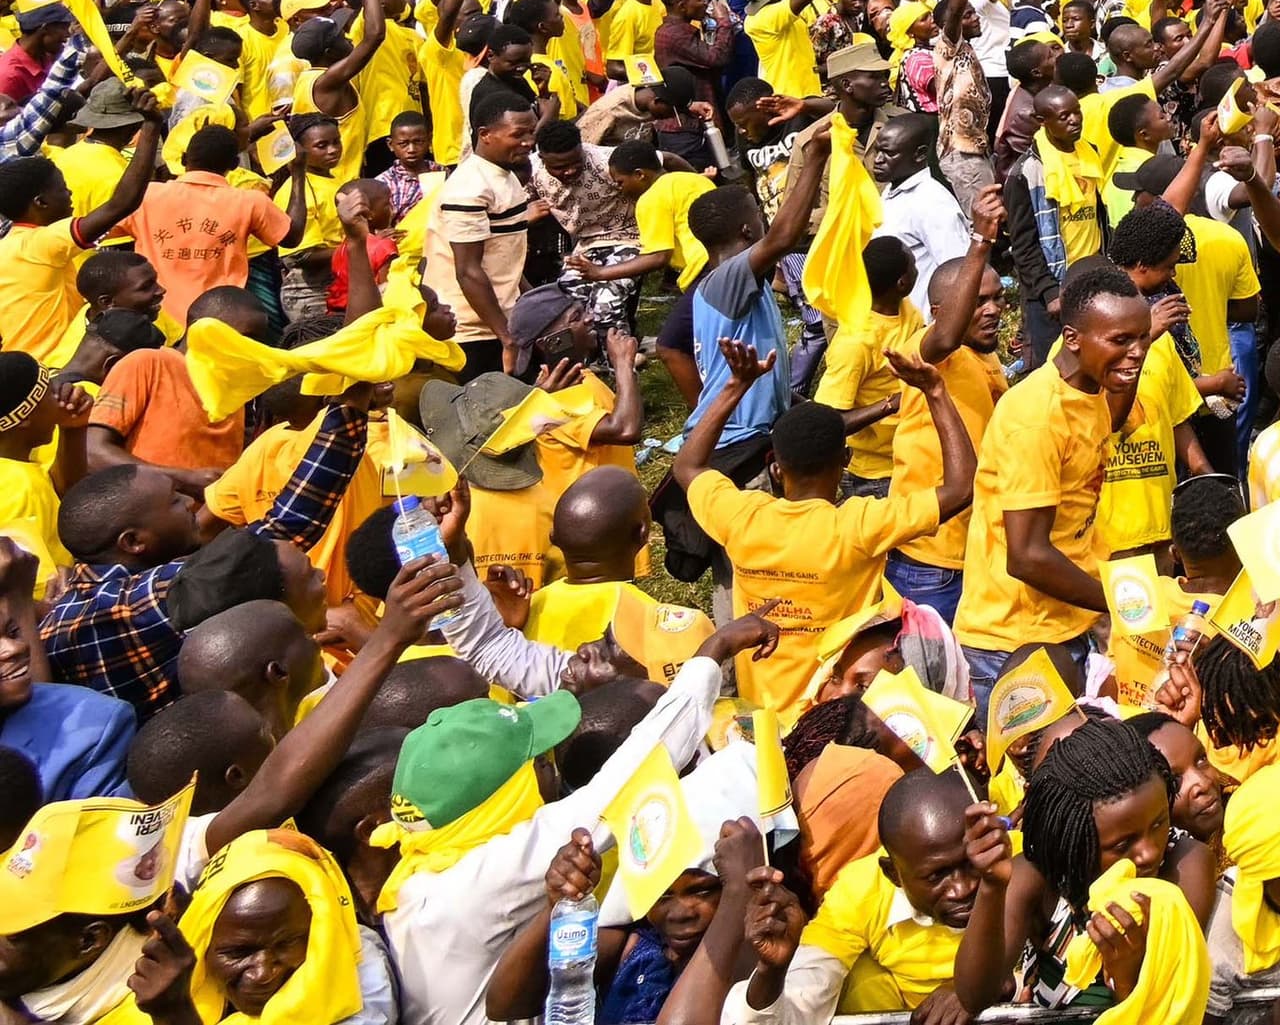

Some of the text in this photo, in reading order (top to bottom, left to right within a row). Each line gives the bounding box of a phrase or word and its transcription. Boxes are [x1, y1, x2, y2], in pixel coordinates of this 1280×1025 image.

[1114, 441, 1160, 455] YOWERI
[1107, 452, 1165, 469] MUSEVENI
[476, 553, 516, 563] ROTECTING
[557, 929, 587, 939] Uzima
